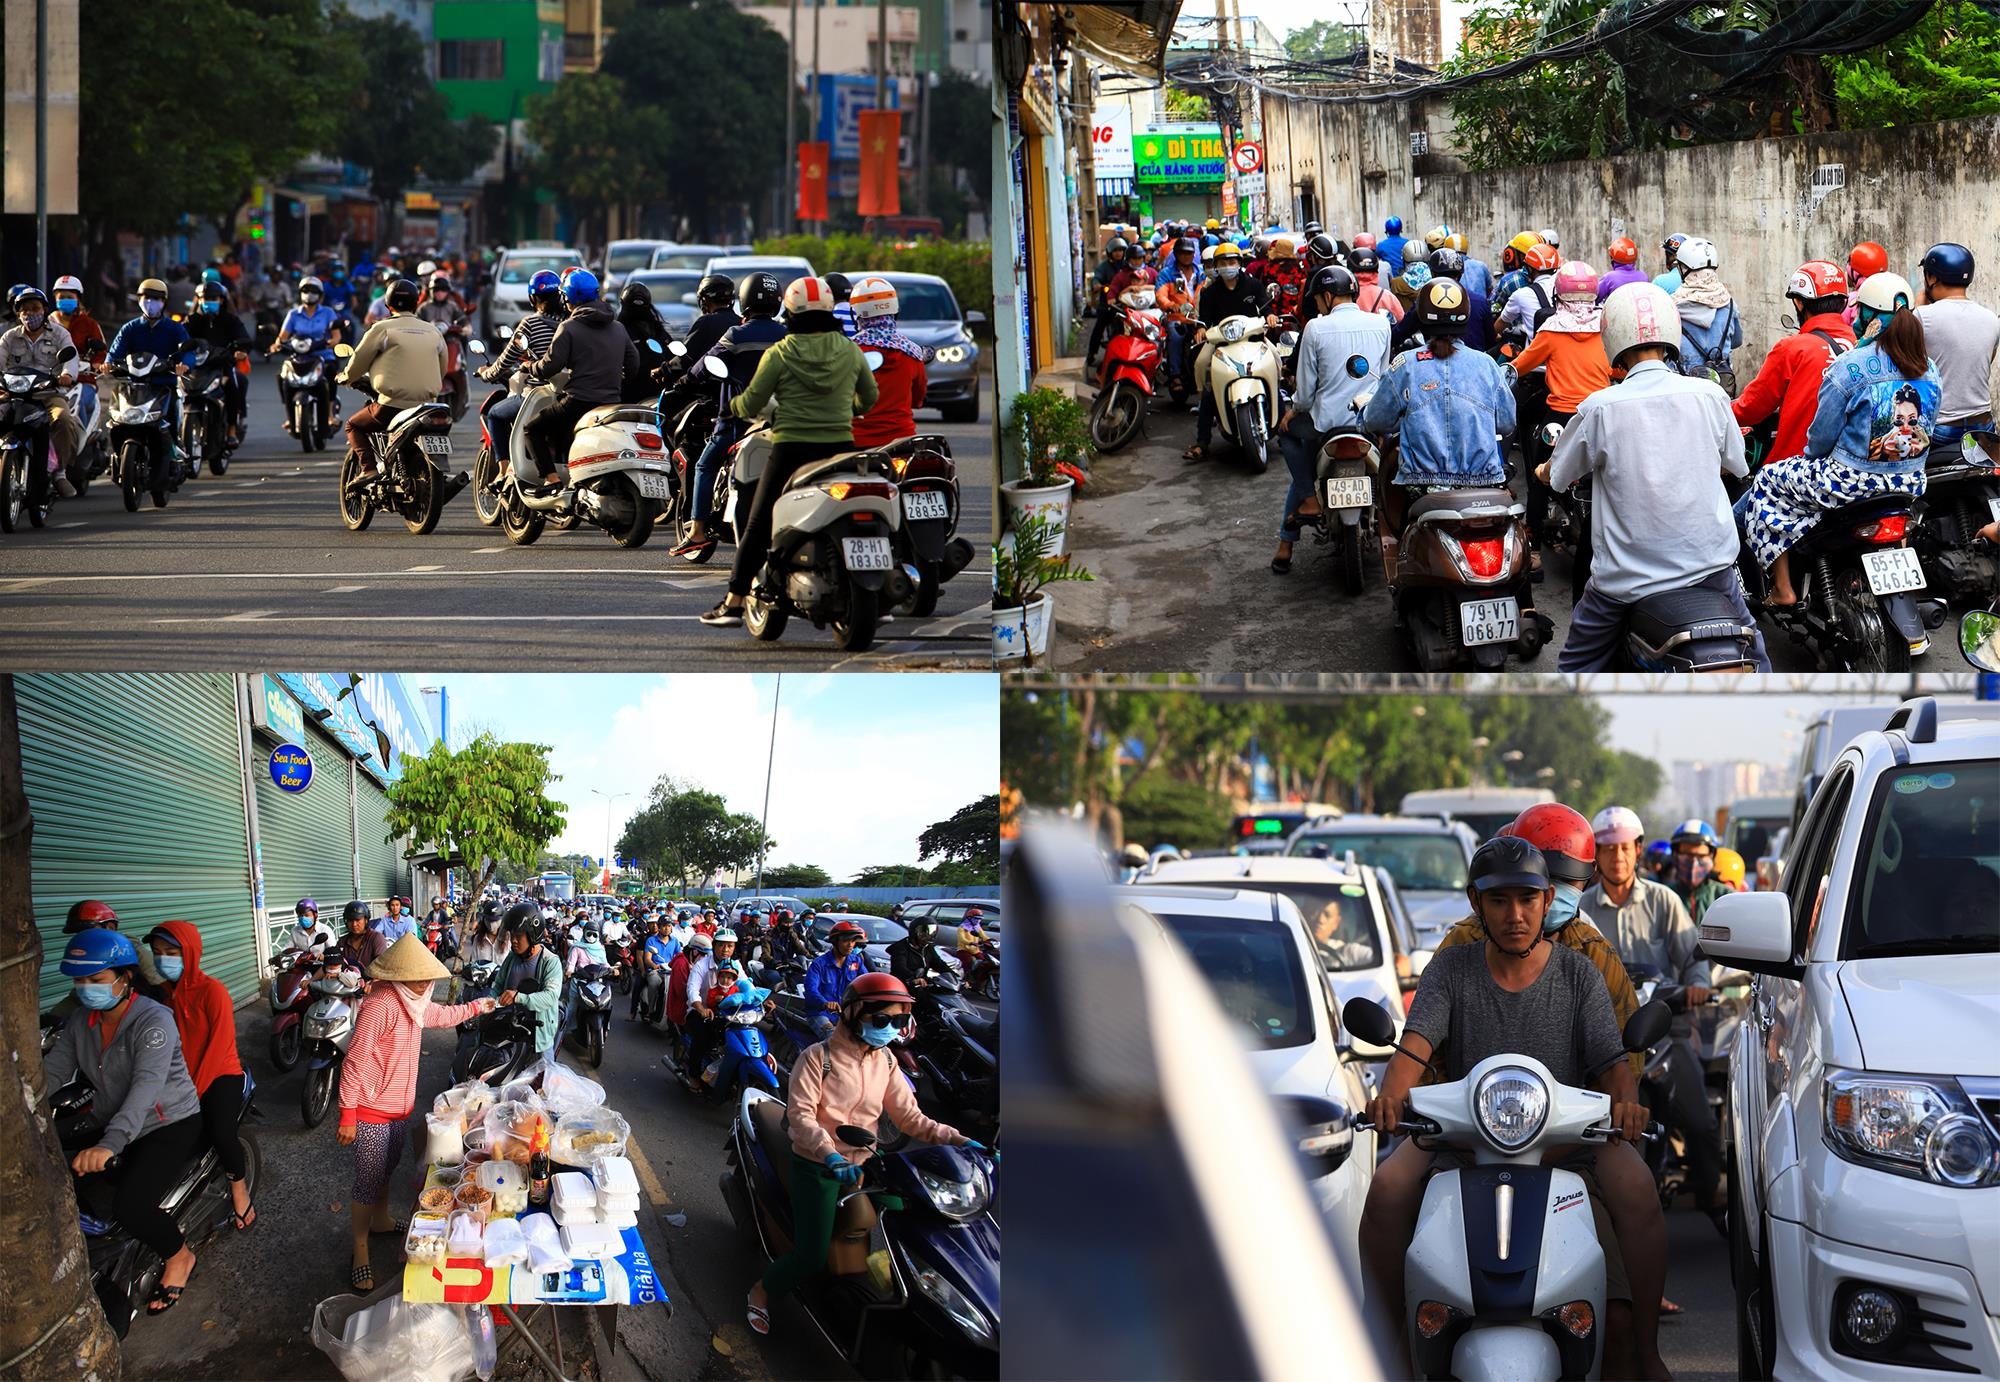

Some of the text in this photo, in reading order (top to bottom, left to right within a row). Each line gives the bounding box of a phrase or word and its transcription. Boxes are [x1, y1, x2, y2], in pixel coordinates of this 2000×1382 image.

[1167, 135, 1227, 159] DÌ THA
[1165, 161, 1195, 176] HÀNG
[874, 302, 890, 310] TCS
[1331, 479, 1365, 493] 49-AD
[908, 492, 938, 506] 72-H1
[1330, 491, 1369, 507] 018.69
[908, 504, 946, 519] 288.55
[850, 539, 884, 554] 28-H1
[849, 554, 890, 569] 183.60
[1870, 551, 1911, 573] 65-F1
[1871, 569, 1922, 592] 546.43
[1469, 601, 1508, 623] 79-V1
[1466, 619, 1515, 643] 068.77
[273, 751, 309, 766] Sea Food
[288, 766, 295, 774] &
[280, 774, 303, 787] Beer
[633, 1251, 656, 1304] Giải ba
